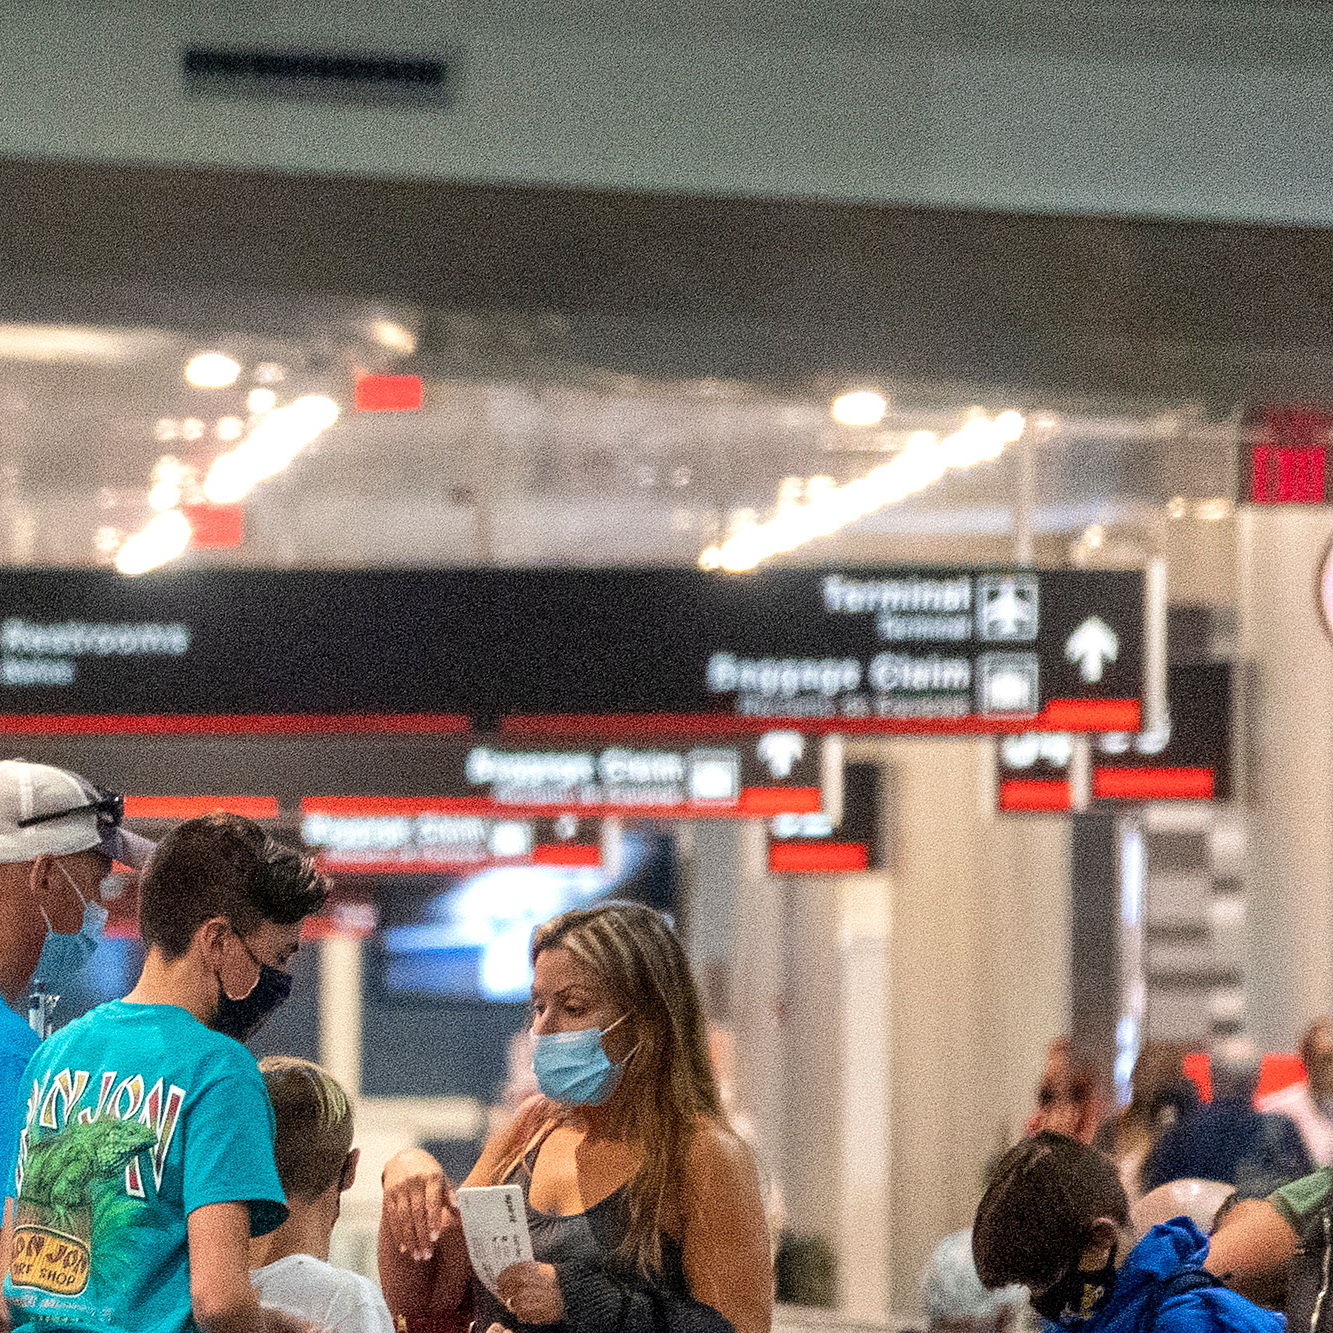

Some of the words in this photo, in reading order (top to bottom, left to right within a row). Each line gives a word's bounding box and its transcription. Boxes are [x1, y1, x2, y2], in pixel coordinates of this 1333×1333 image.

[824, 575, 971, 613] Terminal
[707, 652, 862, 697] Baggage
[869, 652, 971, 691] Claim
[39, 1267, 76, 1286] SHOP
